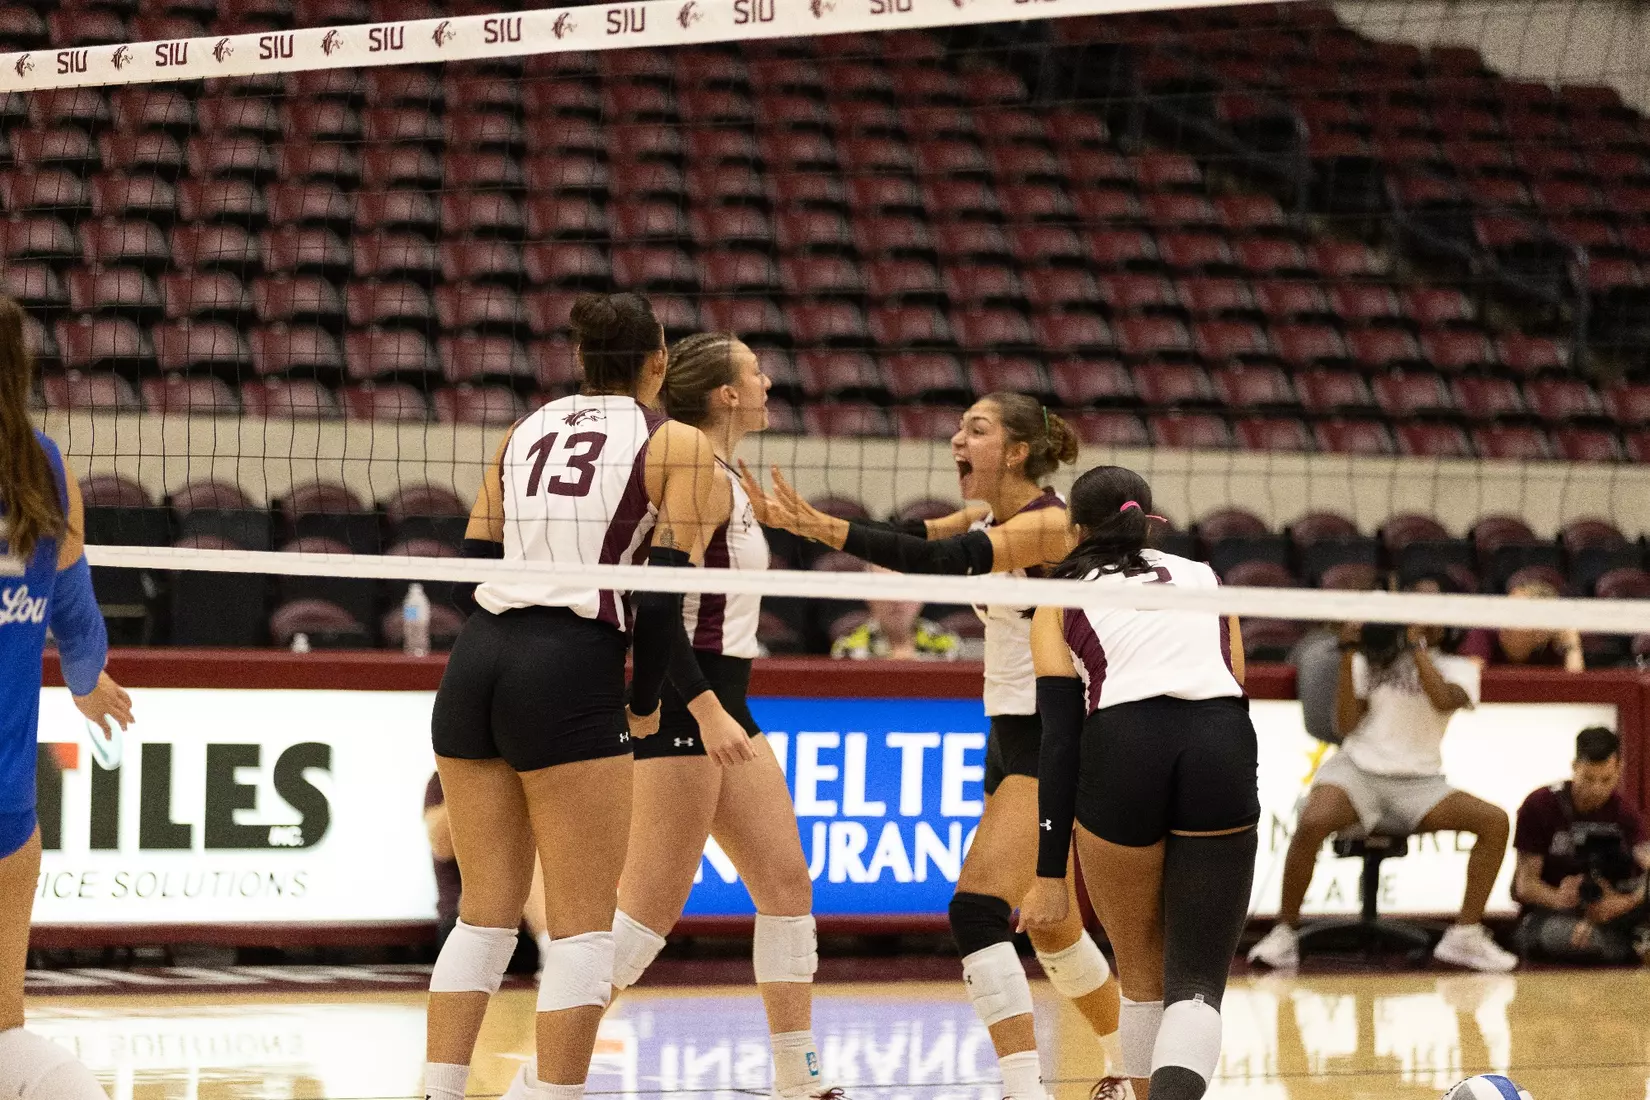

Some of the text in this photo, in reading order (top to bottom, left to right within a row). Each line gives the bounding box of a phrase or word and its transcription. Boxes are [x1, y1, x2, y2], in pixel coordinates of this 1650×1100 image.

[56, 49, 88, 75] SIU
[155, 41, 189, 67] SIU
[259, 34, 294, 60] SIU
[368, 25, 405, 53] SIU
[483, 17, 522, 44] SIU
[606, 7, 646, 35] SIU
[733, 0, 775, 25] SIU
[525, 430, 608, 497] 13
[38, 870, 310, 899] ICE SOLUTIONS
